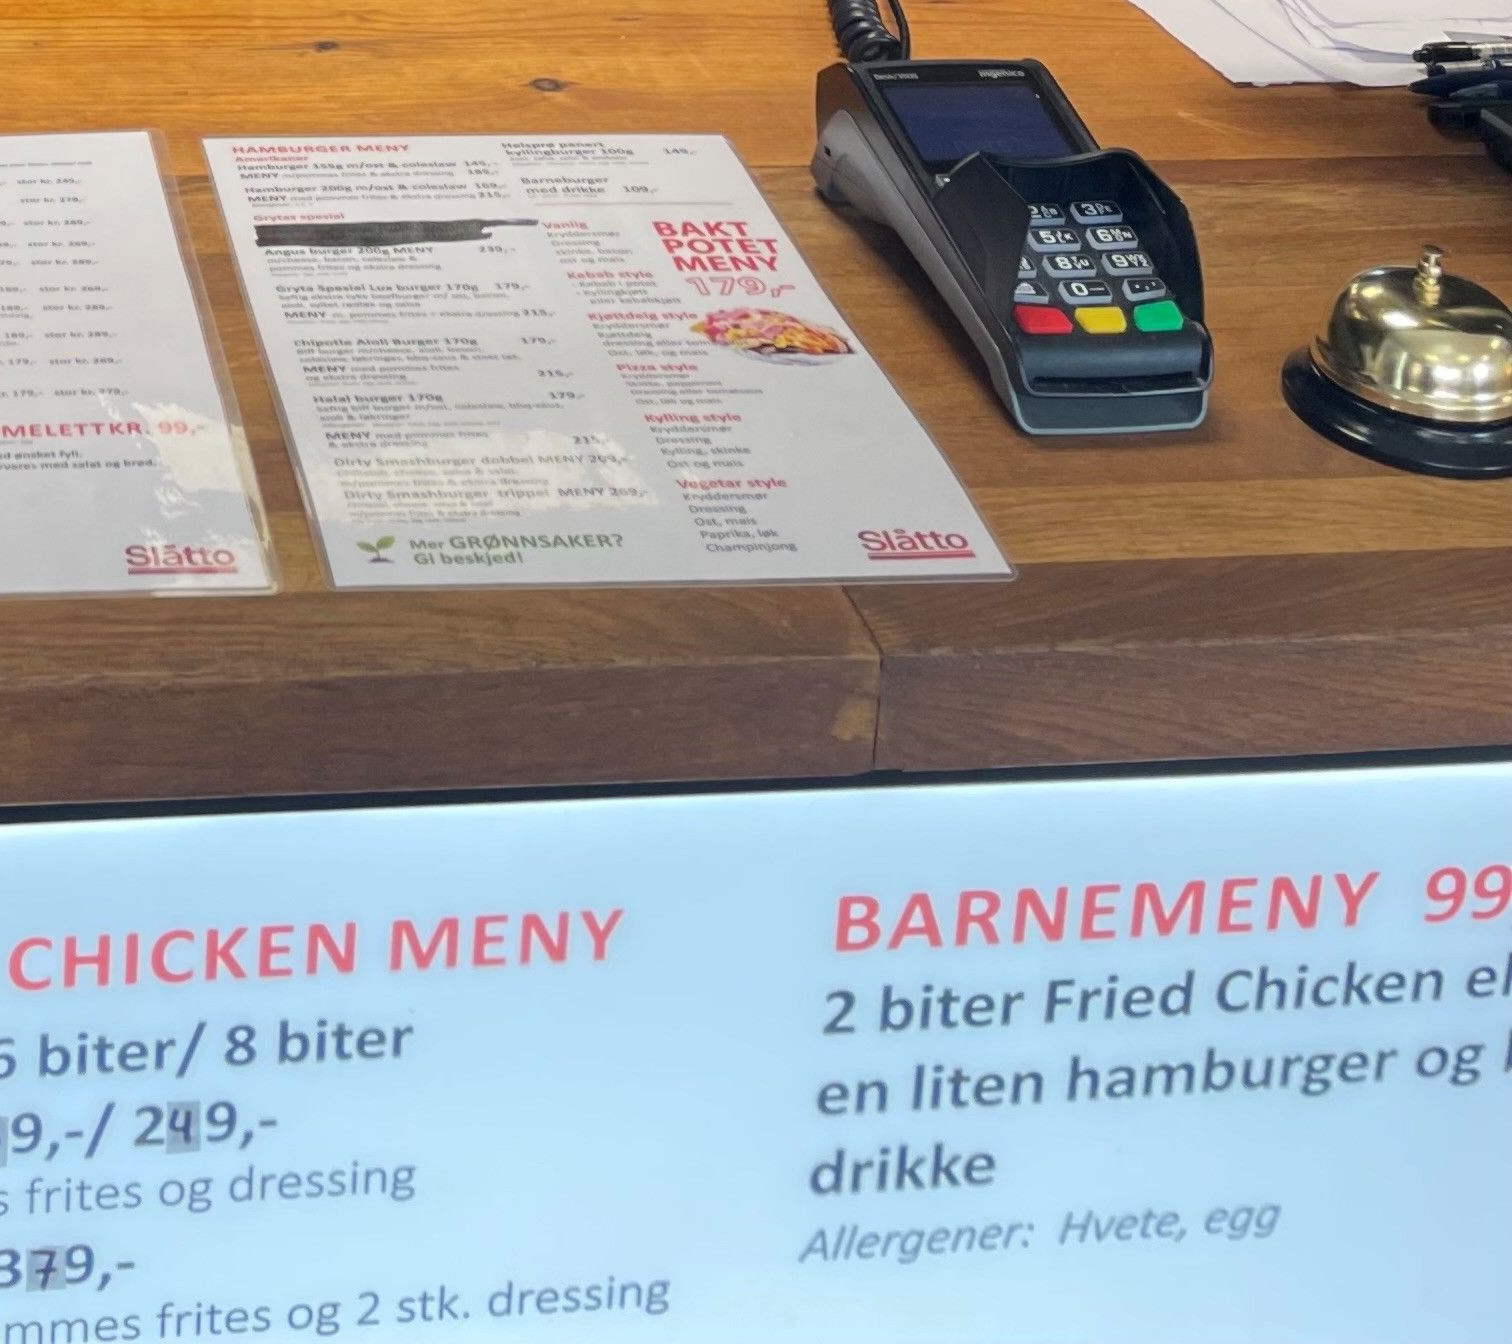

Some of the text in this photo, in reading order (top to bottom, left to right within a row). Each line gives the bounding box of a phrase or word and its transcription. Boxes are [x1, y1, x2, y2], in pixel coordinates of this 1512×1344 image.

[232, 144, 410, 154] HAMBURGER MENY
[520, 176, 609, 184] Barneburger
[562, 186, 606, 194] drikke
[542, 222, 588, 230] Vanlig
[652, 220, 748, 237] BAKT
[310, 246, 354, 256] burger
[393, 246, 434, 254] MENY
[662, 238, 778, 254] POTET
[671, 256, 778, 272] MENY
[618, 271, 654, 280] style
[686, 276, 796, 298] 179,-
[662, 312, 698, 320] style
[616, 363, 698, 371] Pizza style
[644, 413, 742, 424] Kylling style
[334, 457, 372, 468] Dirty
[375, 455, 477, 467] Smashburger
[539, 455, 584, 464] MENY
[675, 478, 788, 490] Vegetar style
[344, 490, 382, 501] Dirty
[387, 489, 489, 500] Smashburger
[558, 487, 604, 497] MENY
[725, 517, 757, 525] mais
[409, 533, 623, 550] Mer GRØNNSAKER?
[700, 529, 755, 540] Paprika,
[858, 529, 968, 551] Slåtto
[125, 544, 236, 567] Slåtto
[706, 543, 798, 552] Champinjong
[414, 553, 436, 564] Gi
[835, 870, 1381, 954] BARNEMENY
[8, 920, 358, 994] CHICKEN
[388, 908, 627, 972] MENY
[821, 989, 857, 1036] 2
[879, 982, 1025, 1032] biter
[1043, 969, 1197, 1024] Fried
[1216, 959, 1445, 1014] Chicken
[37, 1021, 207, 1082] biter/
[225, 1023, 258, 1068] 8
[277, 1017, 416, 1065] biter
[816, 1075, 889, 1115] en
[911, 1062, 1045, 1112] liten
[1066, 1041, 1397, 1103] hamburger
[1415, 1044, 1484, 1086] og
[133, 1098, 279, 1151] 249,-
[809, 1142, 997, 1196] drikke
[25, 1175, 143, 1217] frites
[158, 1174, 213, 1214] og
[228, 1158, 418, 1204] dressing
[797, 1200, 1282, 1265] Allergener: Hvete, egg
[156, 1300, 272, 1338] frites
[287, 1301, 341, 1337] og
[356, 1291, 380, 1326] 2
[396, 1285, 471, 1323] stk.
[487, 1276, 672, 1317] dressing
